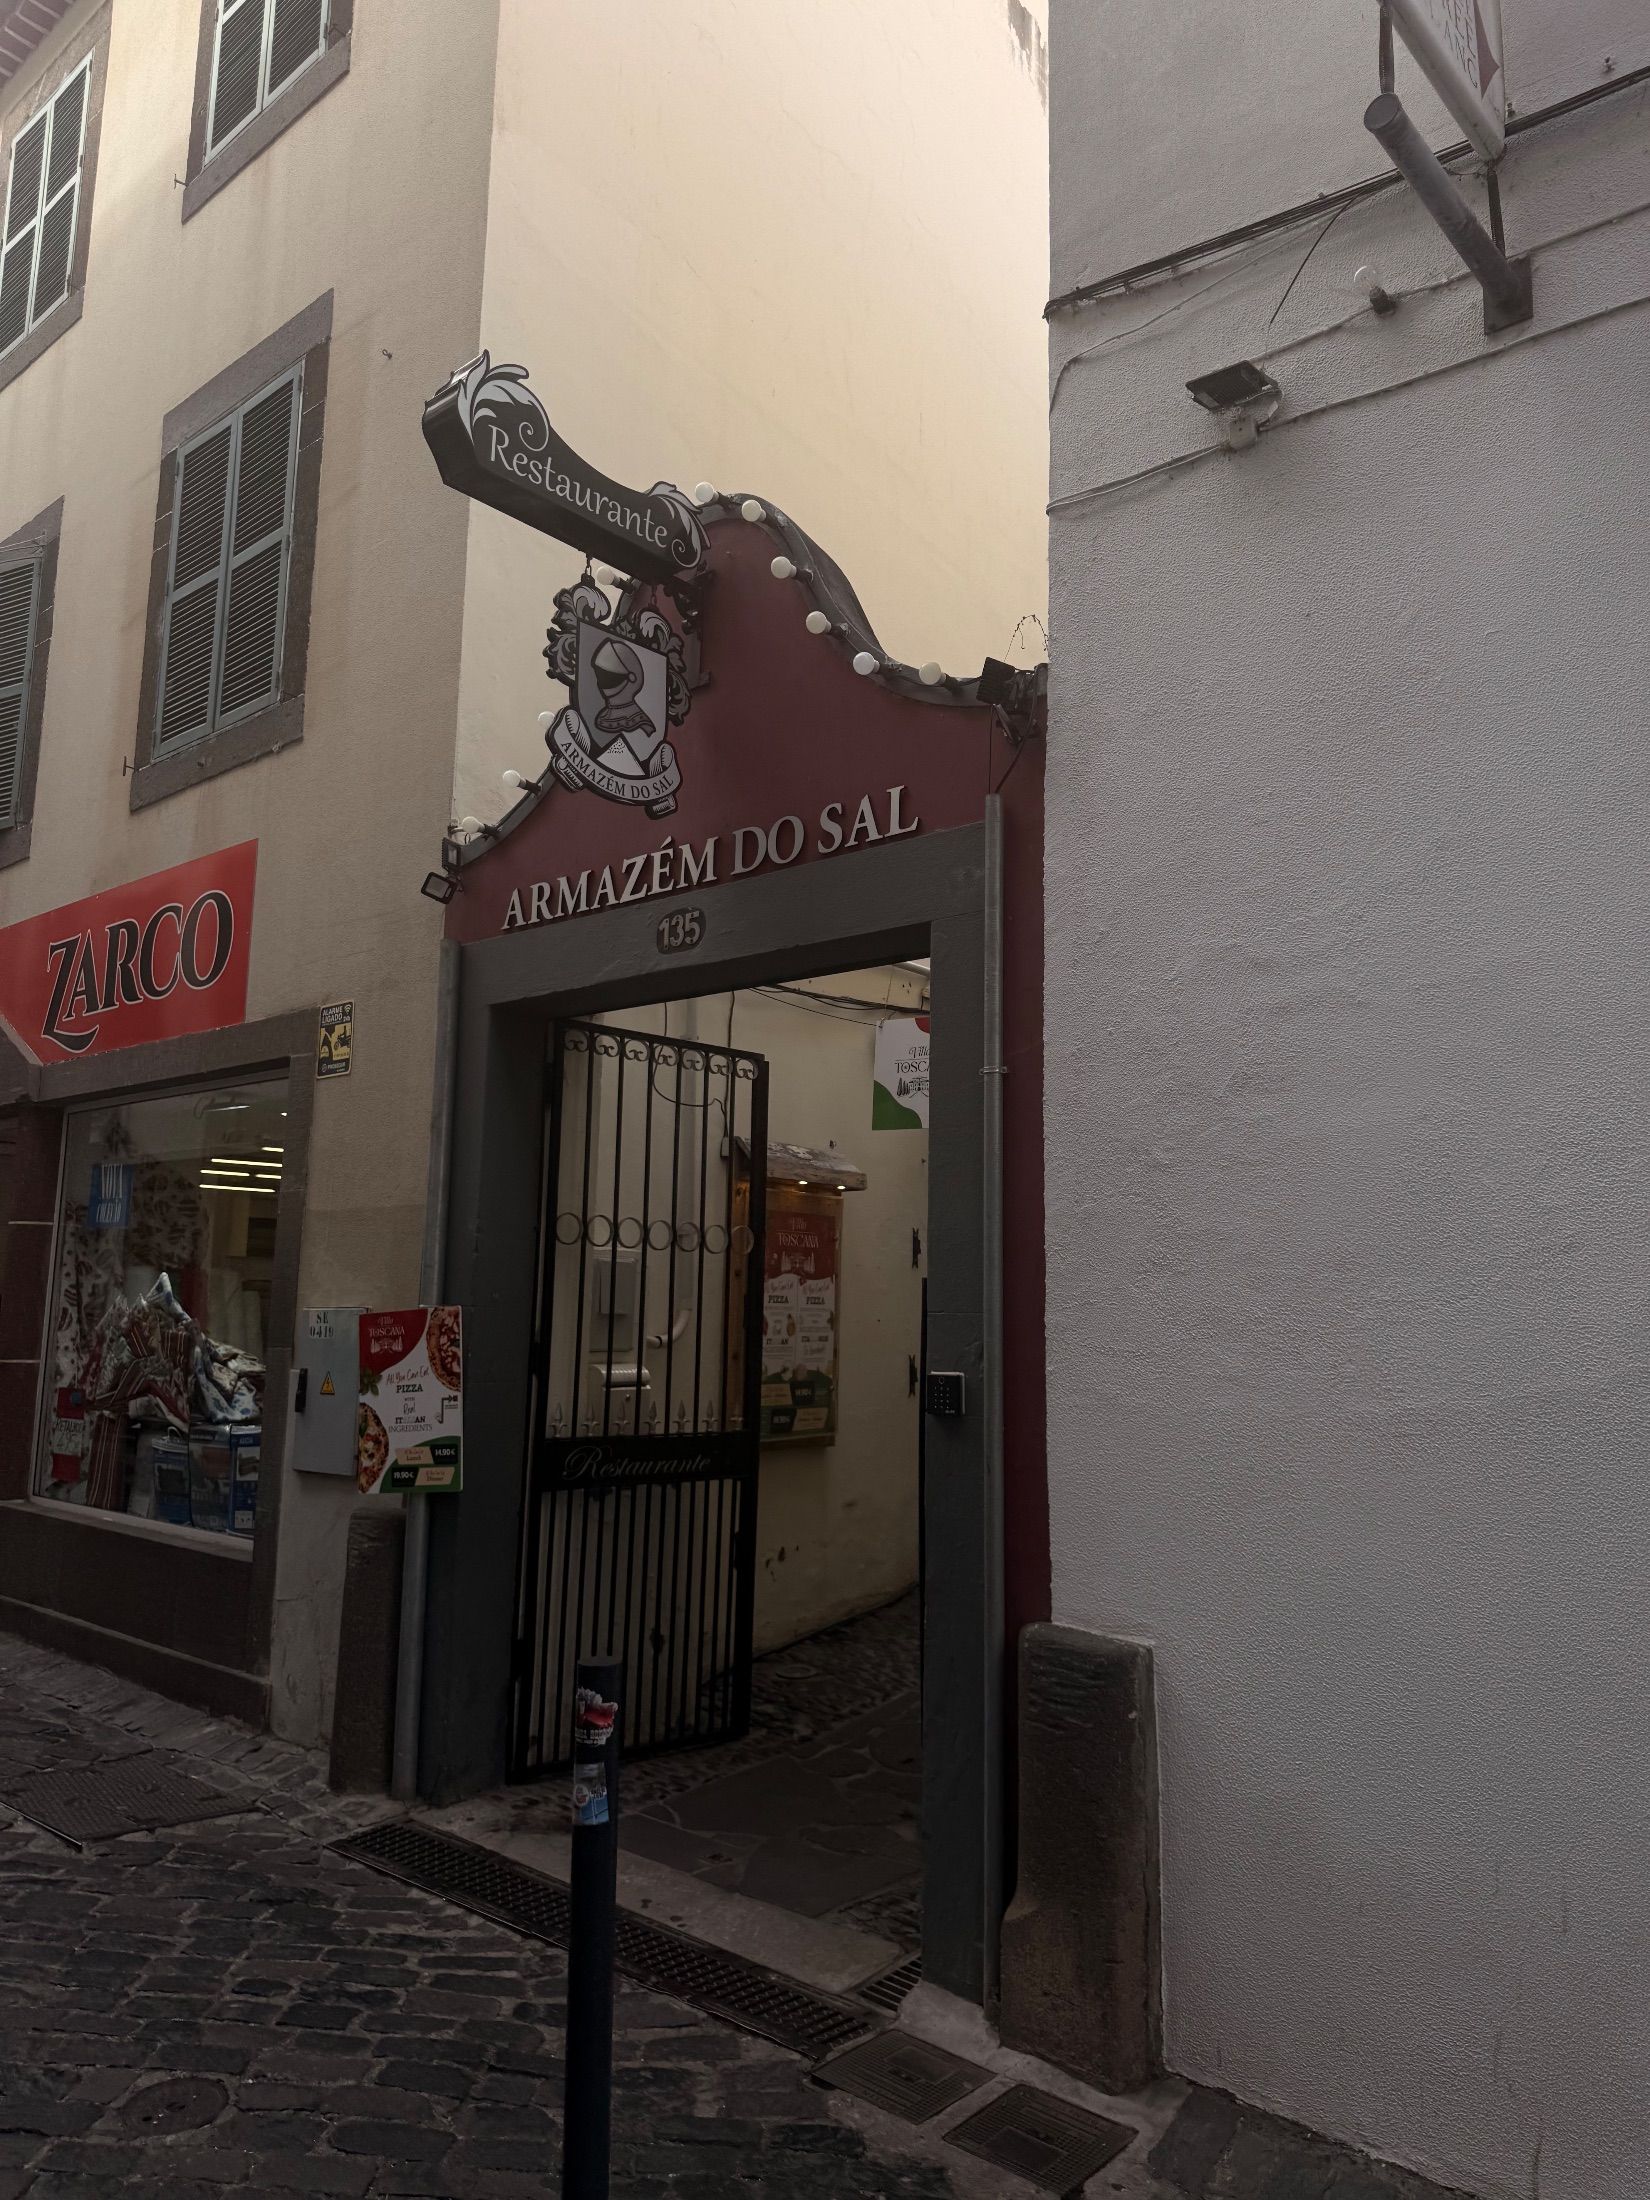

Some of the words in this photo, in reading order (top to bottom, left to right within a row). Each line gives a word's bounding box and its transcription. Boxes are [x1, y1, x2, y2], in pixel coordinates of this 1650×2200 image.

[488, 424, 667, 548] Restaurante
[561, 742, 626, 797] ARMAZÉM
[631, 785, 650, 799] DO
[652, 775, 674, 796] SAL
[501, 836, 720, 930] ARMAZÉM
[729, 815, 806, 876] DO
[817, 785, 920, 855] SAL
[658, 908, 701, 949] 135
[41, 890, 234, 1053] ZARCO
[322, 1005, 343, 1016] ALARME
[322, 1013, 343, 1024] LIGADO
[776, 1232, 819, 1248] TOSCANA
[768, 1295, 789, 1304] PIZZA
[806, 1296, 826, 1305] PIZZA
[368, 1326, 406, 1338] TOSCANA
[396, 1384, 423, 1393] PIZZA
[395, 1416, 426, 1424] ITAN
[388, 1424, 433, 1433] INGREDIENTS
[561, 1445, 711, 1480] Restaurante
